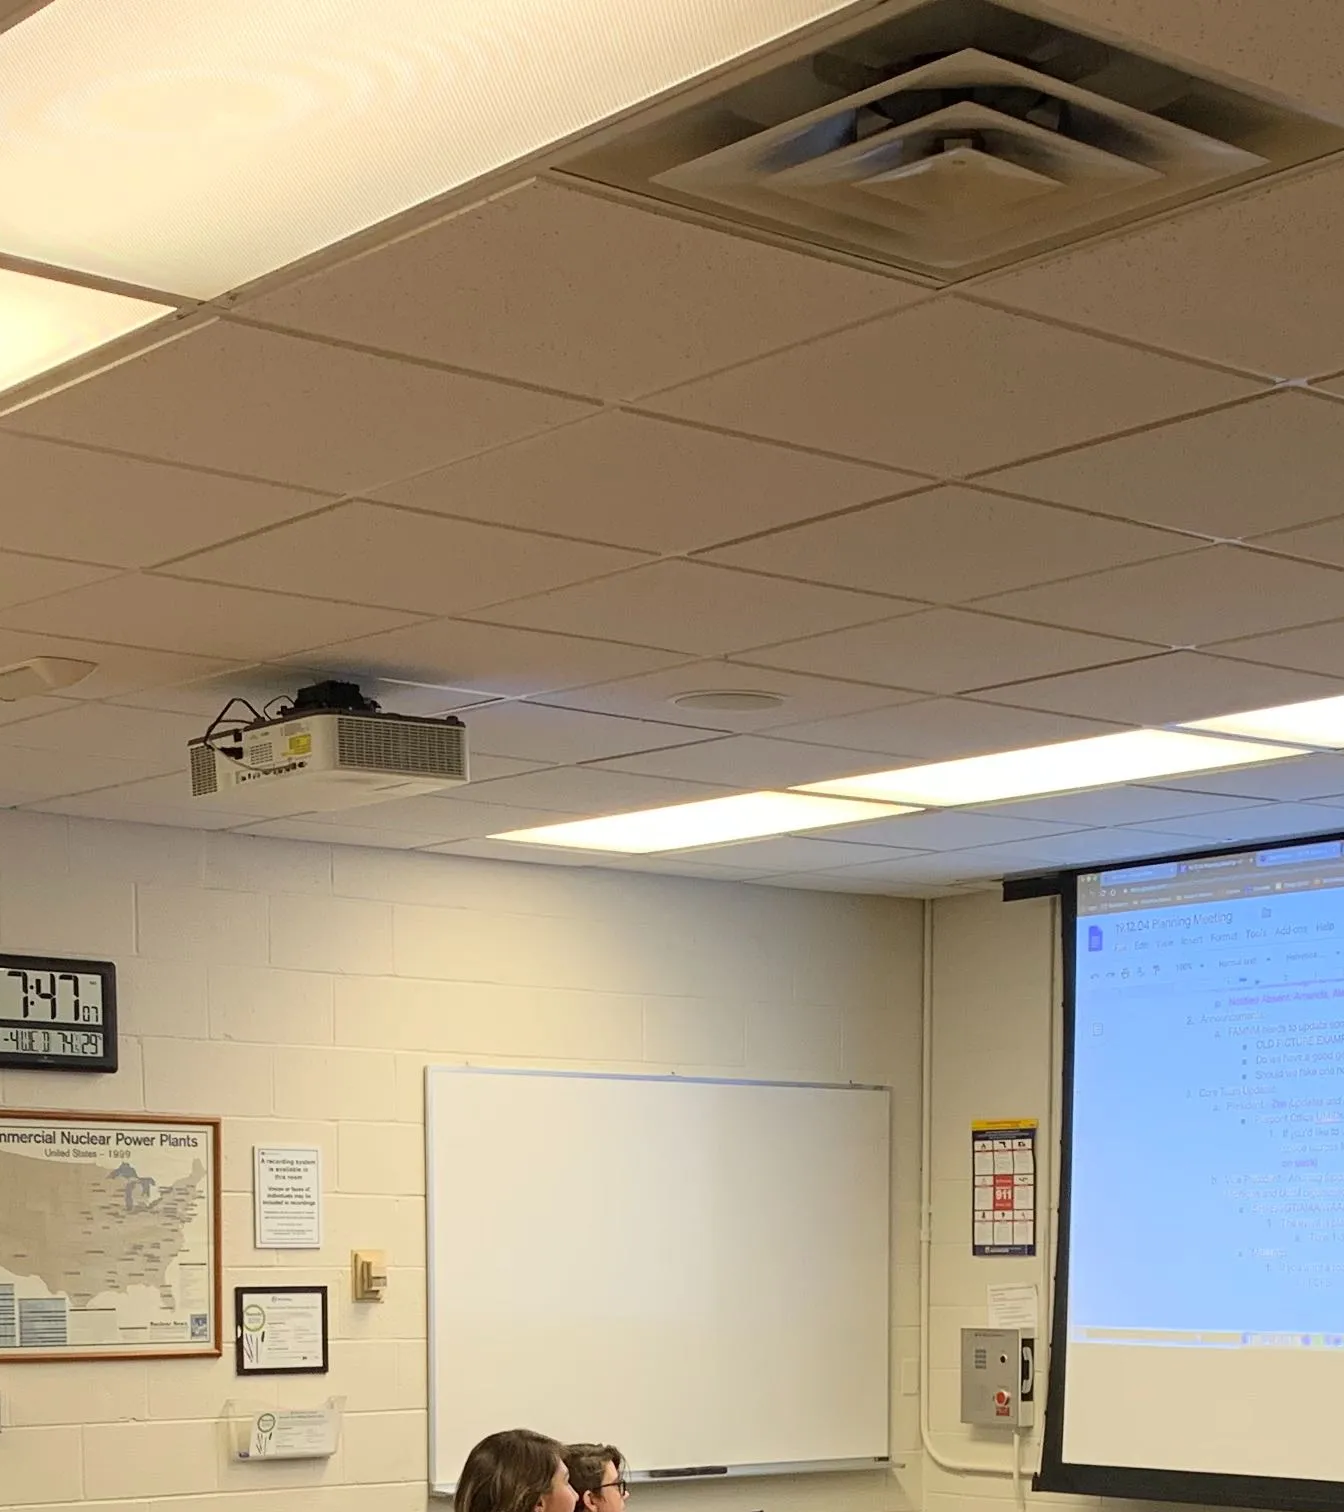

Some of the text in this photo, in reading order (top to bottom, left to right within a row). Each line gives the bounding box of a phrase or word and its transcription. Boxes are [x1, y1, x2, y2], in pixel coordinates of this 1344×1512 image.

[1152, 914, 1192, 930] Planning
[1193, 911, 1233, 927] Meeting
[1210, 932, 1239, 942] Format
[1275, 924, 1309, 937] Add-ons
[1316, 920, 1336, 933] Help
[7, 971, 99, 1023] 7:47 07
[1312, 1050, 1334, 1063] good
[60, 1131, 111, 1146] Nuclear
[115, 1132, 156, 1147] Power
[159, 1133, 199, 1148] Plants
[44, 1148, 70, 1158] United
[72, 1149, 98, 1159] States
[995, 1188, 1012, 1201] 911
